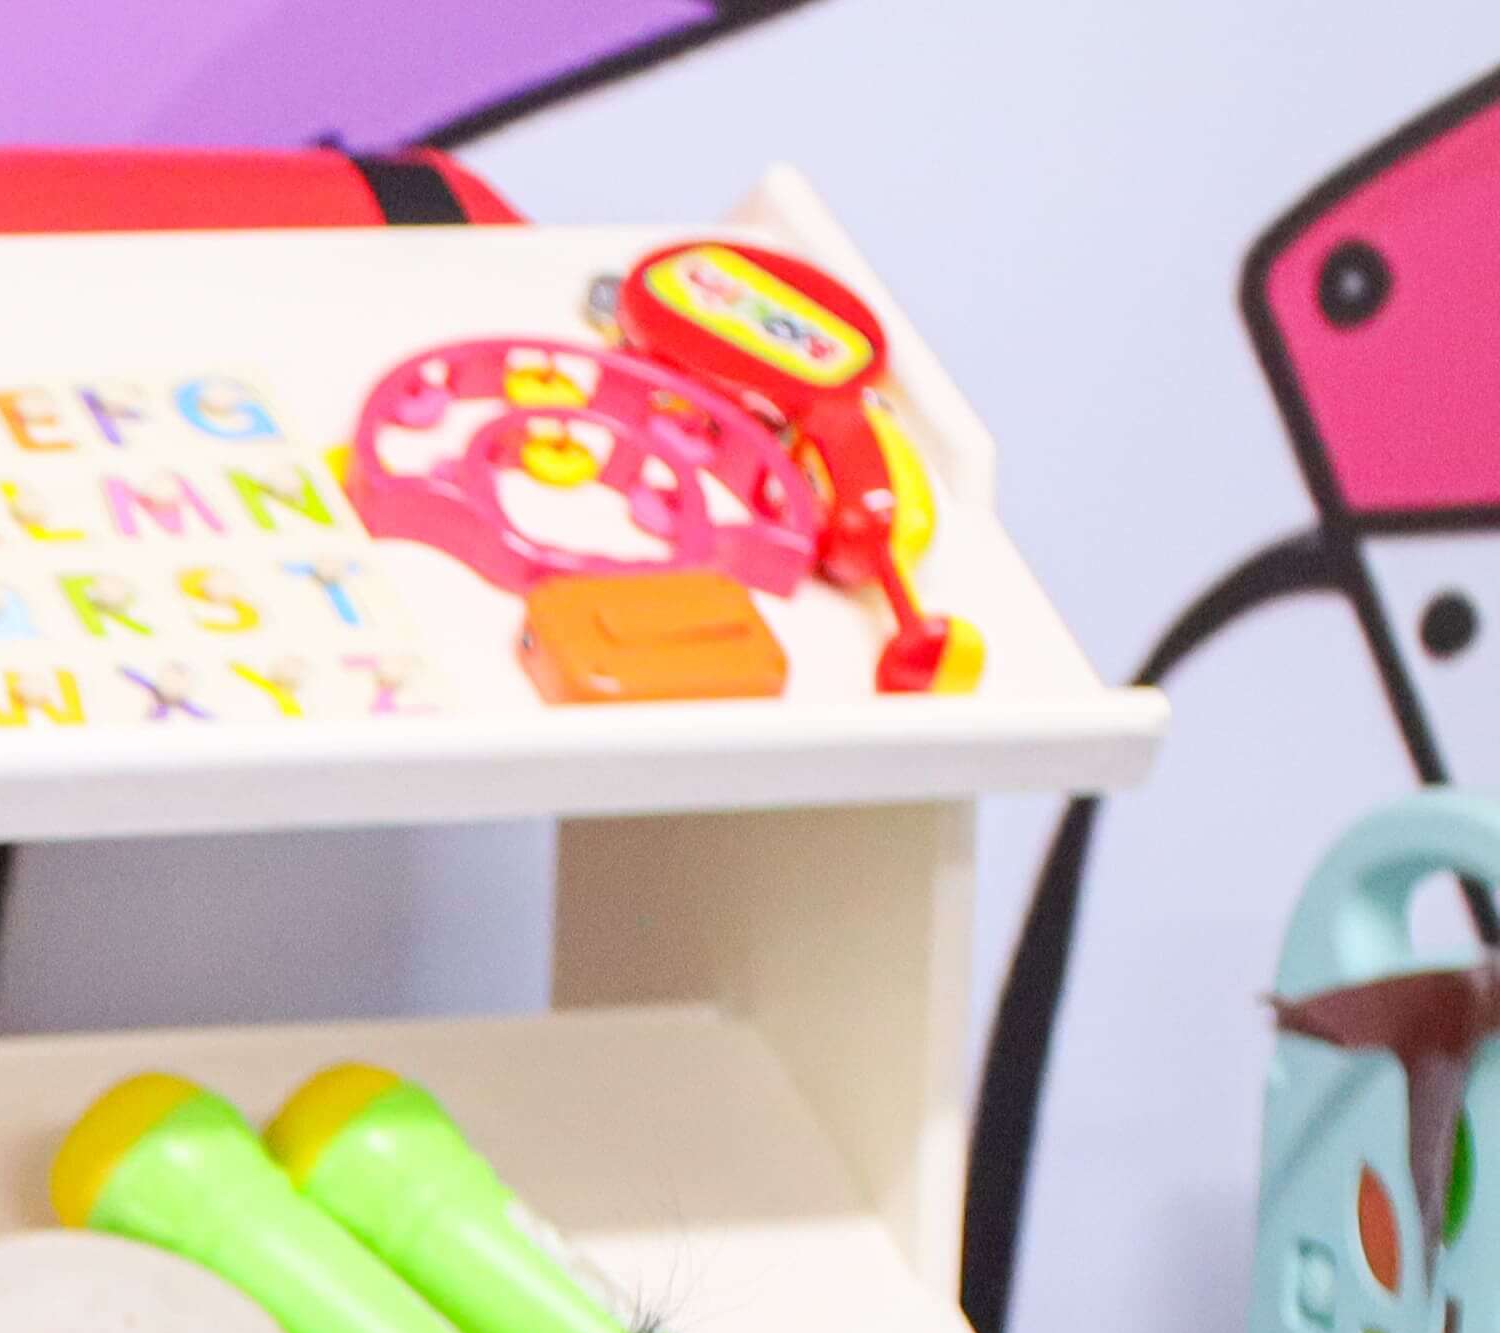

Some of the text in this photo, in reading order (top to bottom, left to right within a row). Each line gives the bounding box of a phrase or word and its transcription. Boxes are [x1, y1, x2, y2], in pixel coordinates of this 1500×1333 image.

[75, 384, 142, 445] F
[173, 377, 283, 439] G
[101, 475, 225, 536] M
[227, 469, 335, 530] N
[57, 574, 153, 637] R
[178, 568, 261, 632] S
[283, 562, 360, 625] T
[118, 666, 216, 720] X
[230, 660, 302, 716] Y
[340, 656, 439, 714] Z
